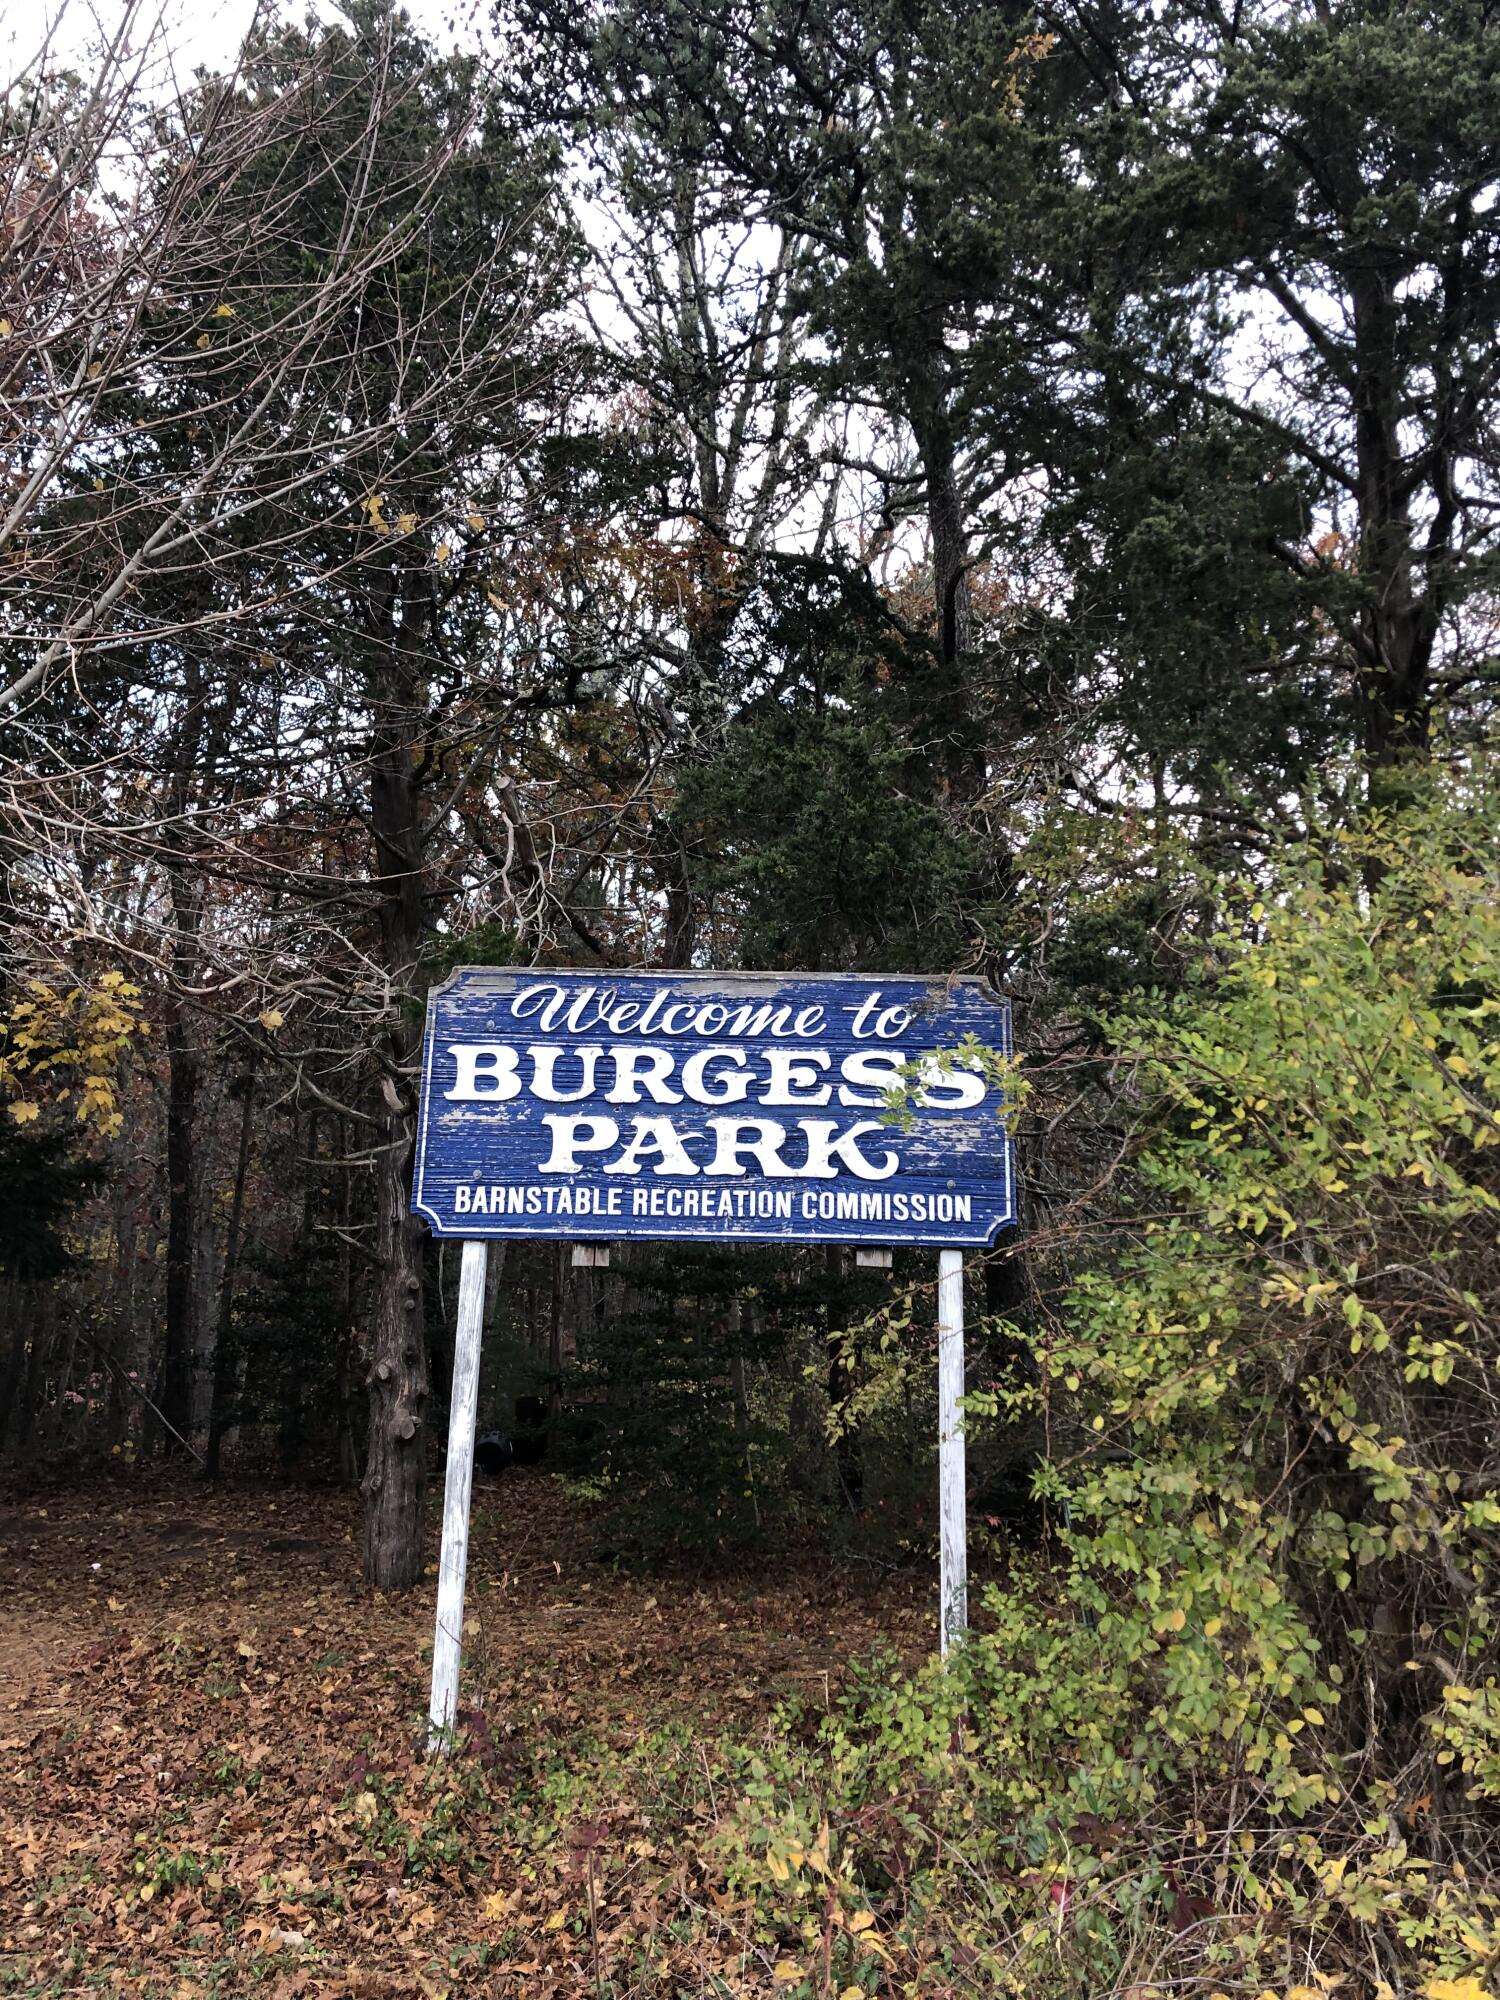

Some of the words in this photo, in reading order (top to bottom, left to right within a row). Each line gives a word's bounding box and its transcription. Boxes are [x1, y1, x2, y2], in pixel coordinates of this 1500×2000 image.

[510, 984, 826, 1037] Welcome
[842, 992, 911, 1039] to
[443, 1044, 987, 1110] BURGESS
[538, 1114, 900, 1181] PARK
[454, 1185, 623, 1216] BARNSTABLE
[632, 1188, 792, 1219] RECREATION
[801, 1191, 973, 1223] COMMISSION
